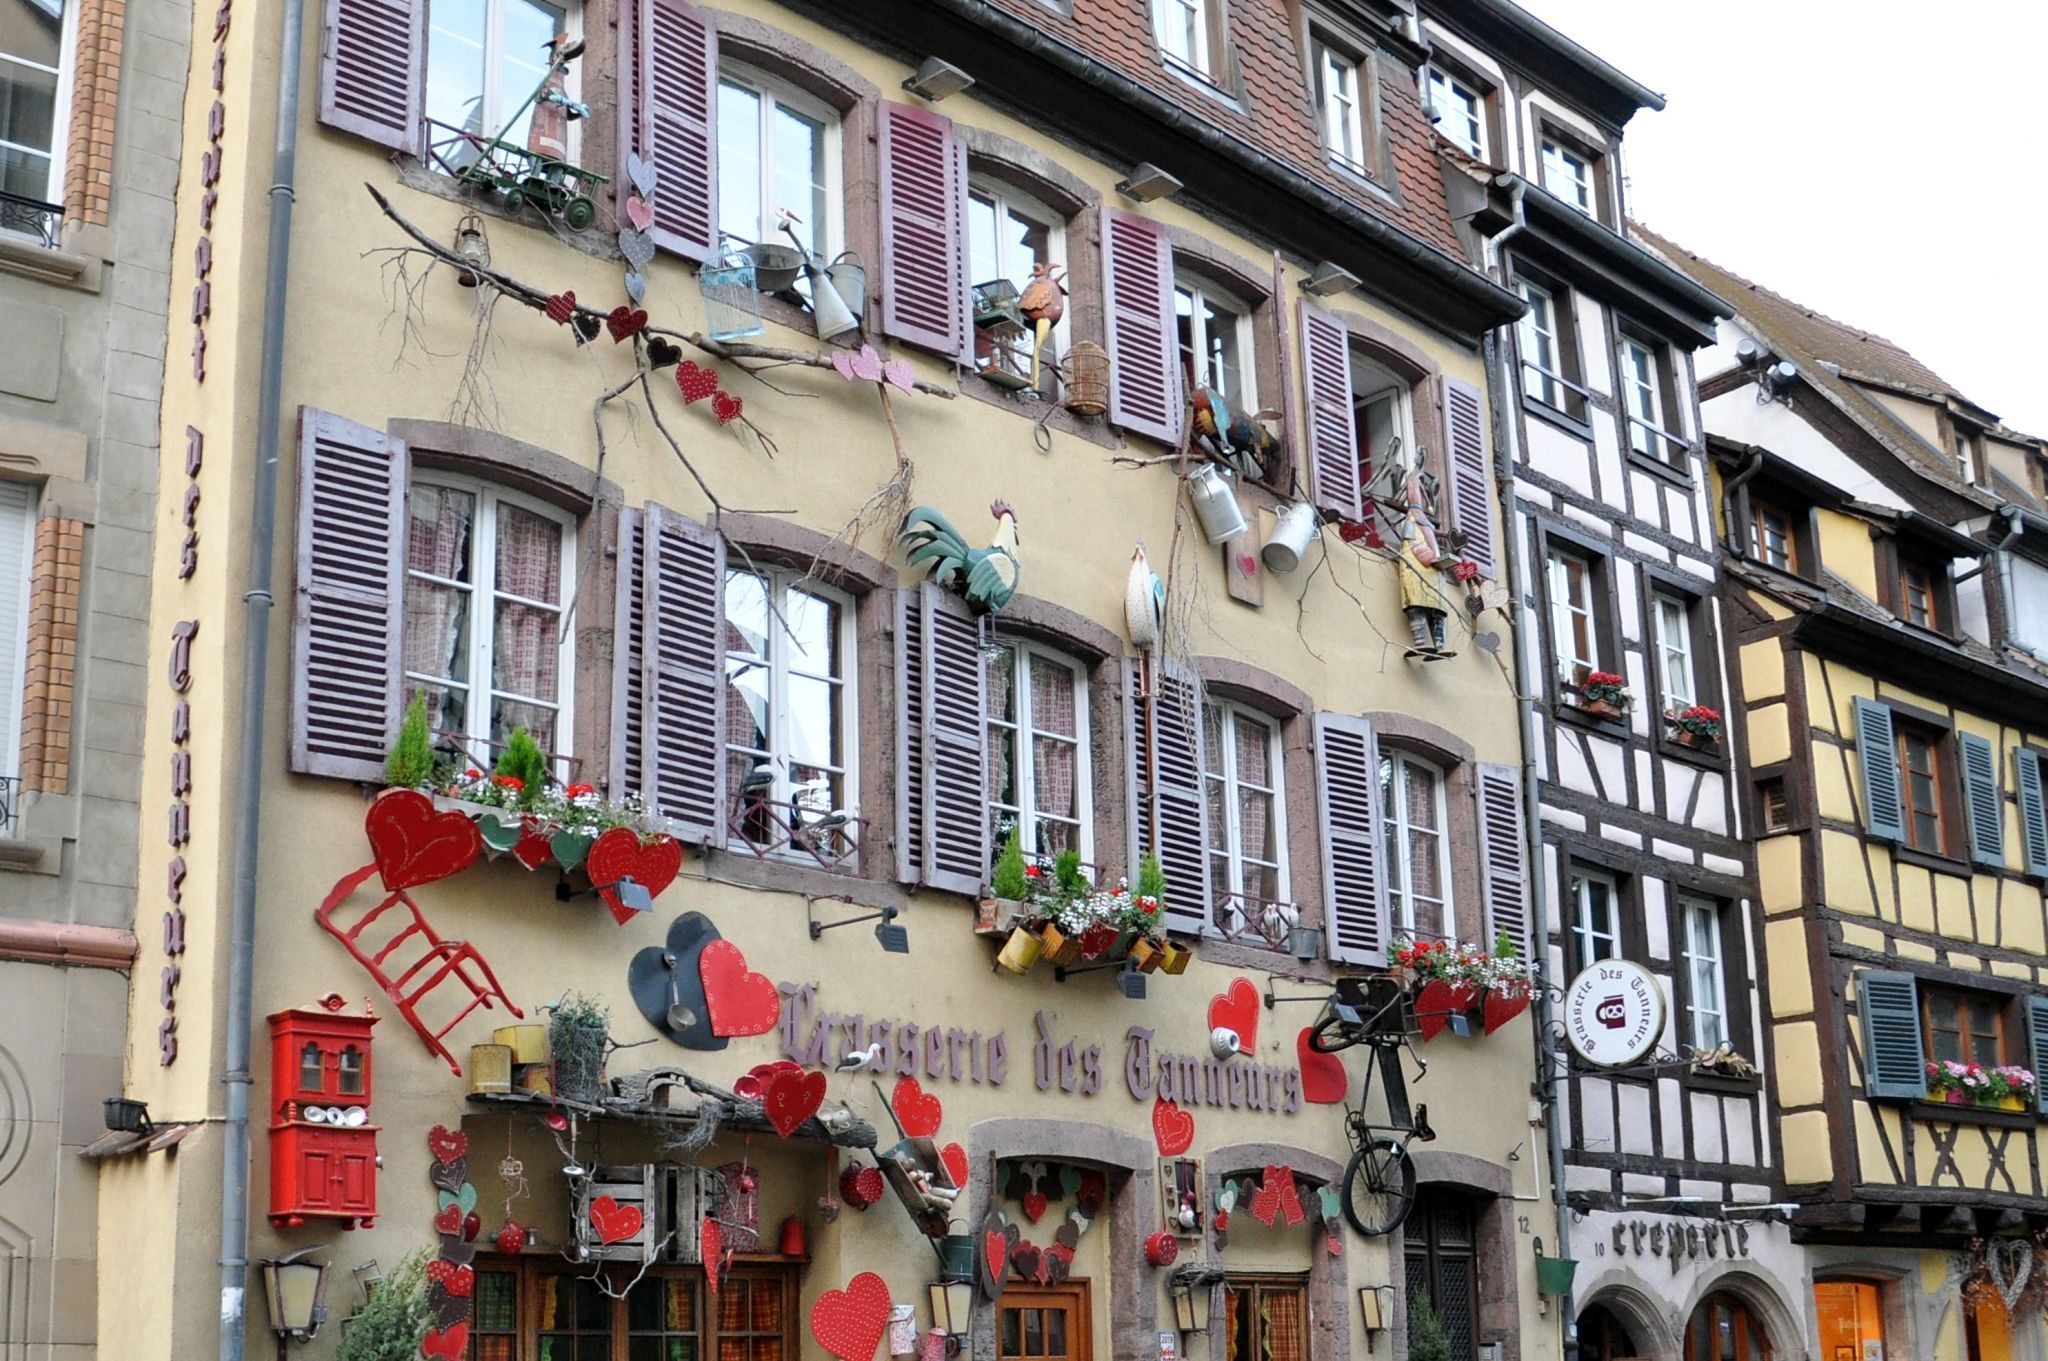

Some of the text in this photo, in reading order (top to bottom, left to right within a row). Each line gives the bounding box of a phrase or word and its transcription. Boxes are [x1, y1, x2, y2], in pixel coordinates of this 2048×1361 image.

[177, 424, 203, 580] des
[158, 619, 200, 1067] Tanneurs
[1573, 968, 1651, 1054] Brasserie des Tanneurs
[1035, 1009, 1101, 1096] des
[1125, 1025, 1301, 1113] Tanneurs
[1518, 1215, 1530, 1234] 12
[1594, 1242, 1605, 1257] 10
